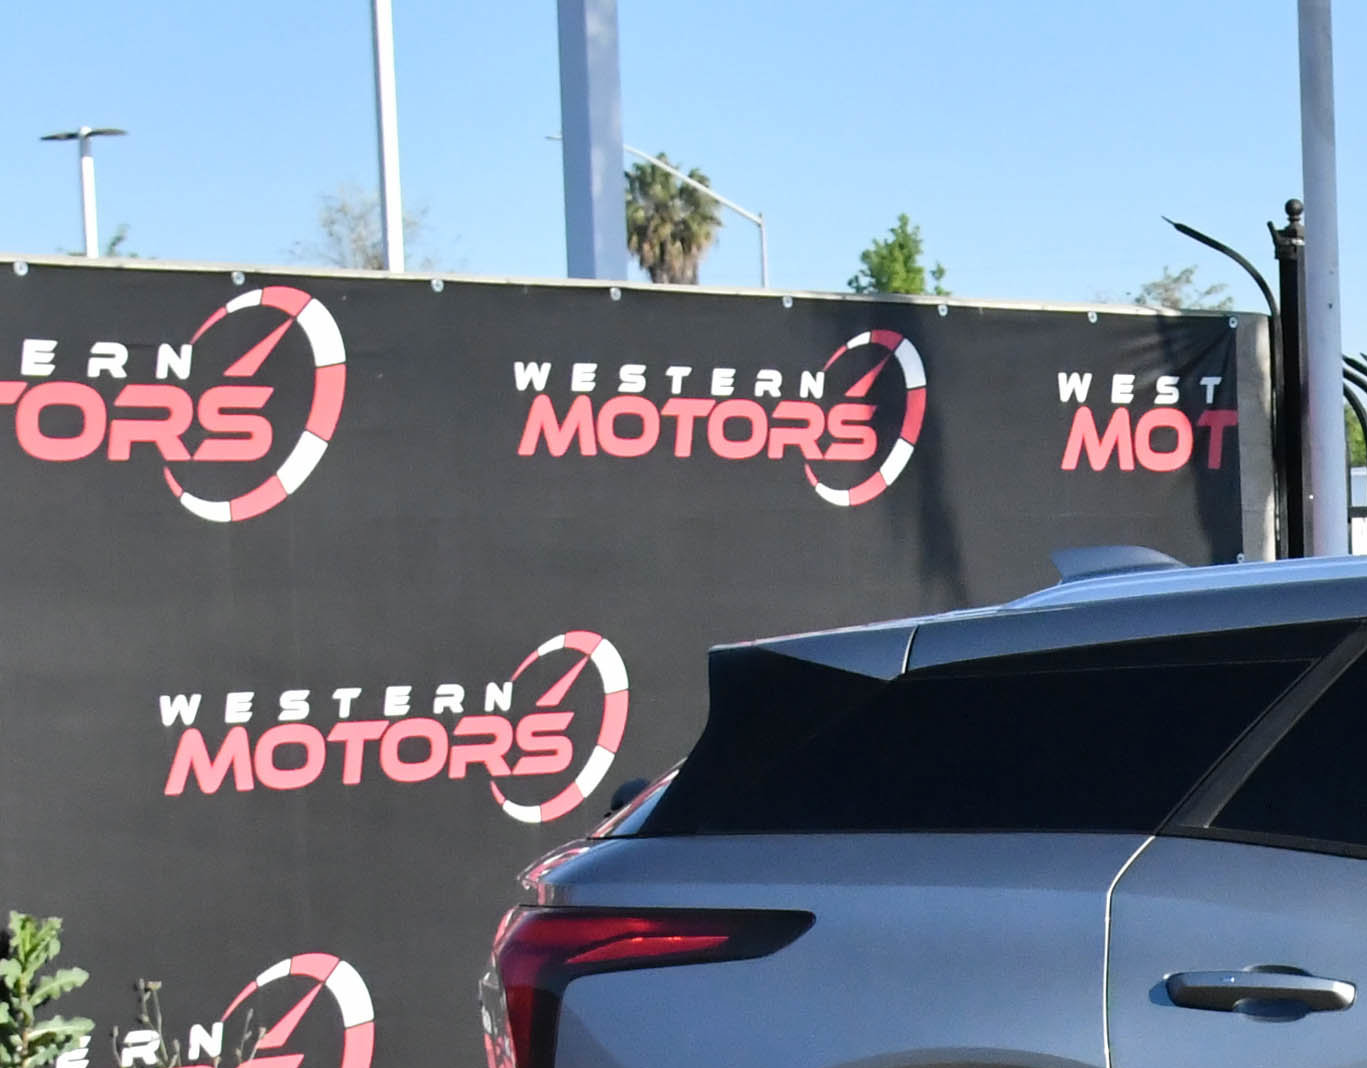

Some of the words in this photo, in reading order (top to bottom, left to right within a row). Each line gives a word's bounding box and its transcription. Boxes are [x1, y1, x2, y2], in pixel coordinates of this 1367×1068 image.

[20, 338, 193, 380] ERN
[513, 361, 825, 400] WESTERN
[1057, 371, 1222, 405] WEST
[517, 393, 877, 462] MOTORS
[1060, 406, 1238, 473] MOT
[159, 681, 513, 728] WESTERN
[164, 710, 574, 796] MOTORS
